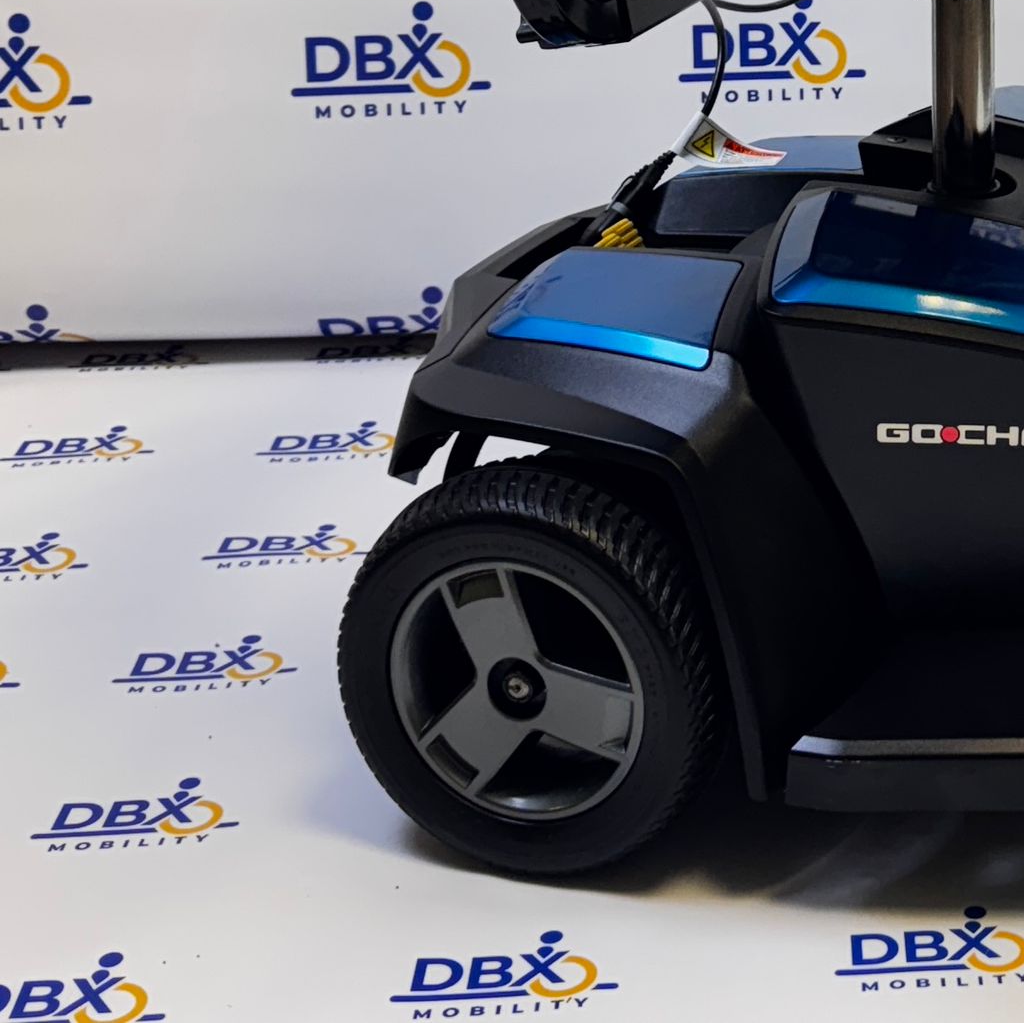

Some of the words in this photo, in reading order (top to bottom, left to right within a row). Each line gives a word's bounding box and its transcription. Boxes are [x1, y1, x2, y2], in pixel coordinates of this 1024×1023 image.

[692, 15, 821, 68] DBX
[304, 33, 442, 83] DBX
[314, 100, 468, 118] MOBILITY
[14, 435, 127, 456] DBX
[270, 430, 379, 452] DBX
[11, 456, 131, 468] MOBILITY
[269, 451, 388, 463] MOBILITY
[217, 535, 338, 553] DBX
[216, 557, 347, 570] MOBILITY
[128, 645, 268, 677] DBX
[128, 678, 272, 694] MOBILITY
[50, 792, 202, 830] DBX
[48, 834, 209, 852] MOBILITY
[849, 926, 1000, 965] DBX
[409, 949, 570, 993] DBX
[413, 996, 588, 1020] MOBILITY
